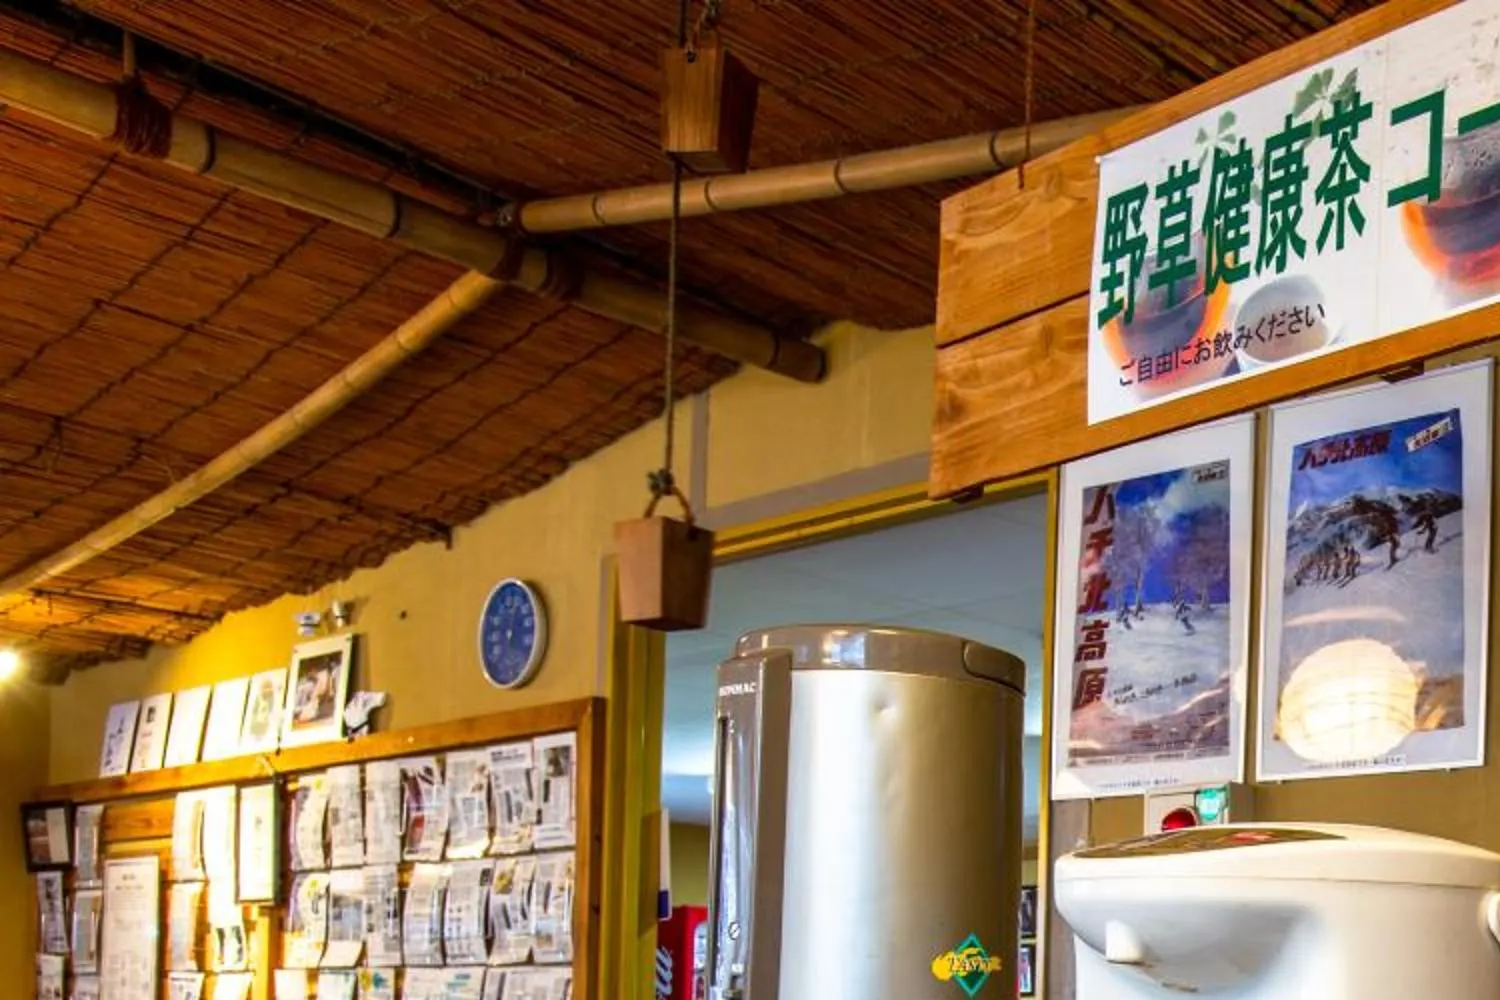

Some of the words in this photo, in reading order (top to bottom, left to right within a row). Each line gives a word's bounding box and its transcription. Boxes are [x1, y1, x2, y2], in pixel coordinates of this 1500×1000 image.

[1119, 302, 1325, 386] ご自由にお飲みください
